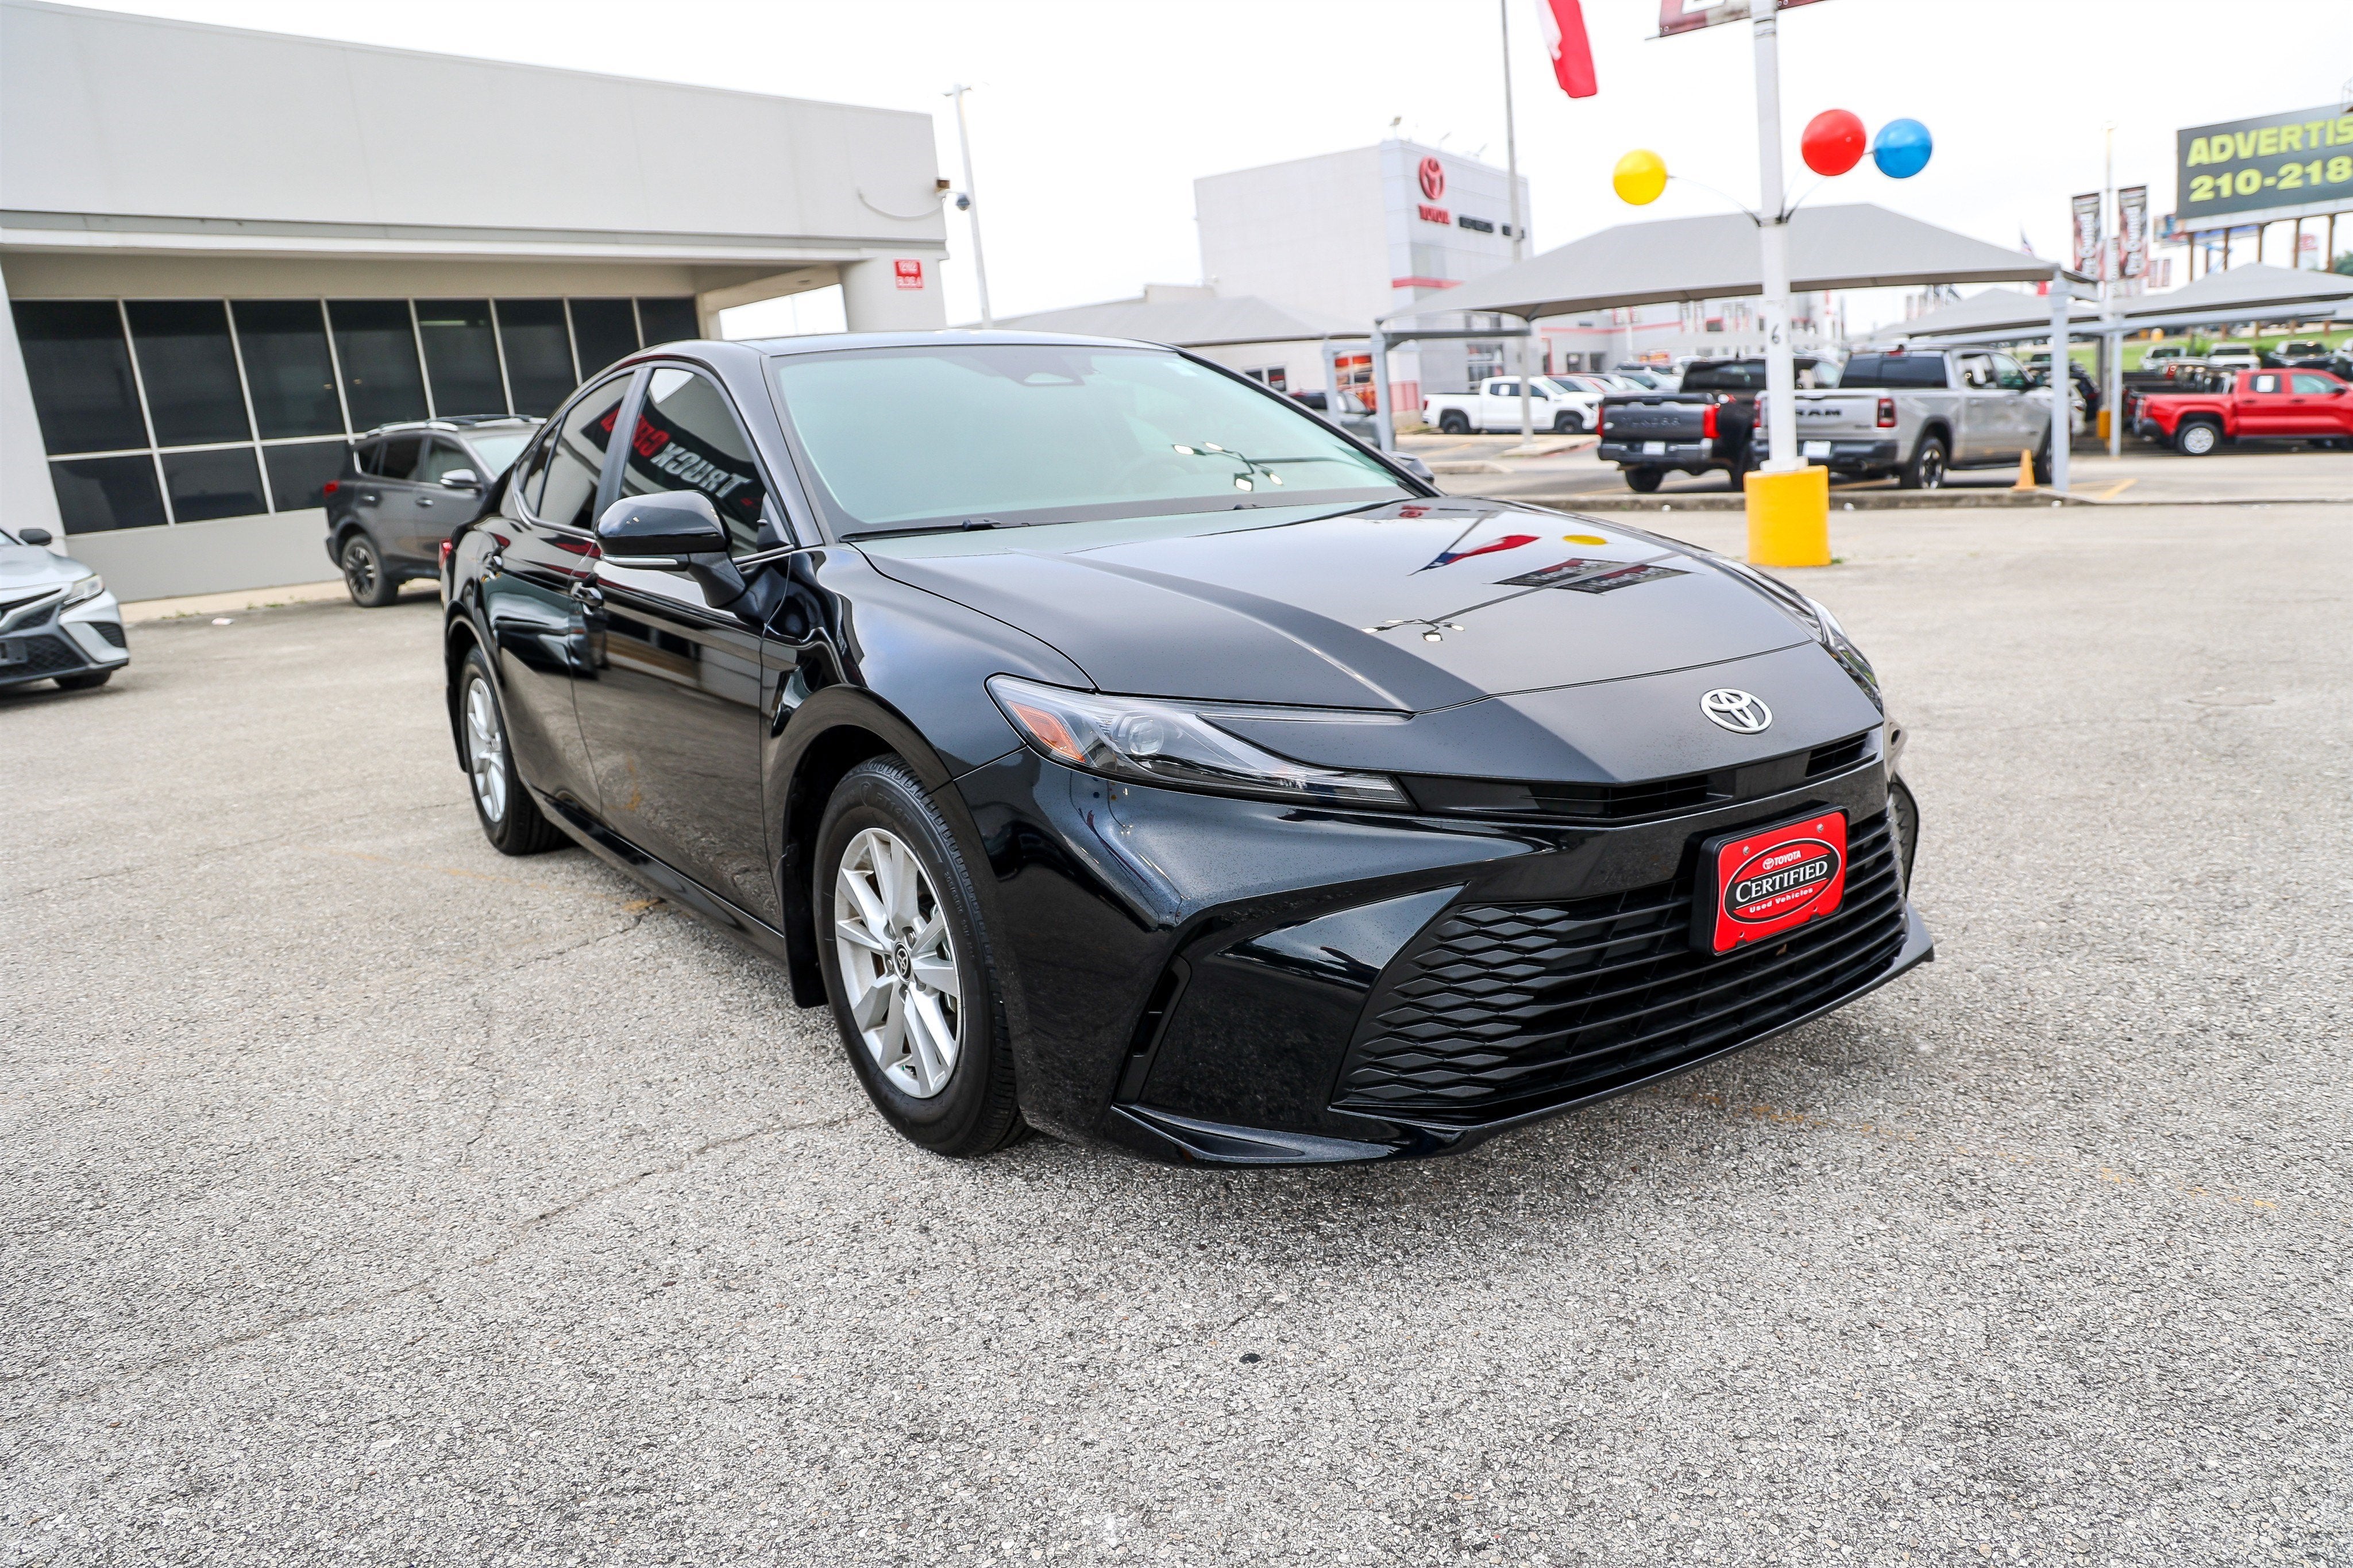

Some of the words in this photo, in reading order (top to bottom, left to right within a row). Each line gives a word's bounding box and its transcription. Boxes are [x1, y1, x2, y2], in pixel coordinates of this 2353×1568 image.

[2186, 115, 2353, 167] ADVERTIS
[2189, 155, 2353, 202] 210-218
[1772, 323, 1780, 344] 6
[1774, 850, 1802, 866] TOYOTA
[1735, 860, 1828, 903] CERTIFIED
[1749, 900, 1773, 913] Used
[1775, 887, 1814, 905] Vehicles
